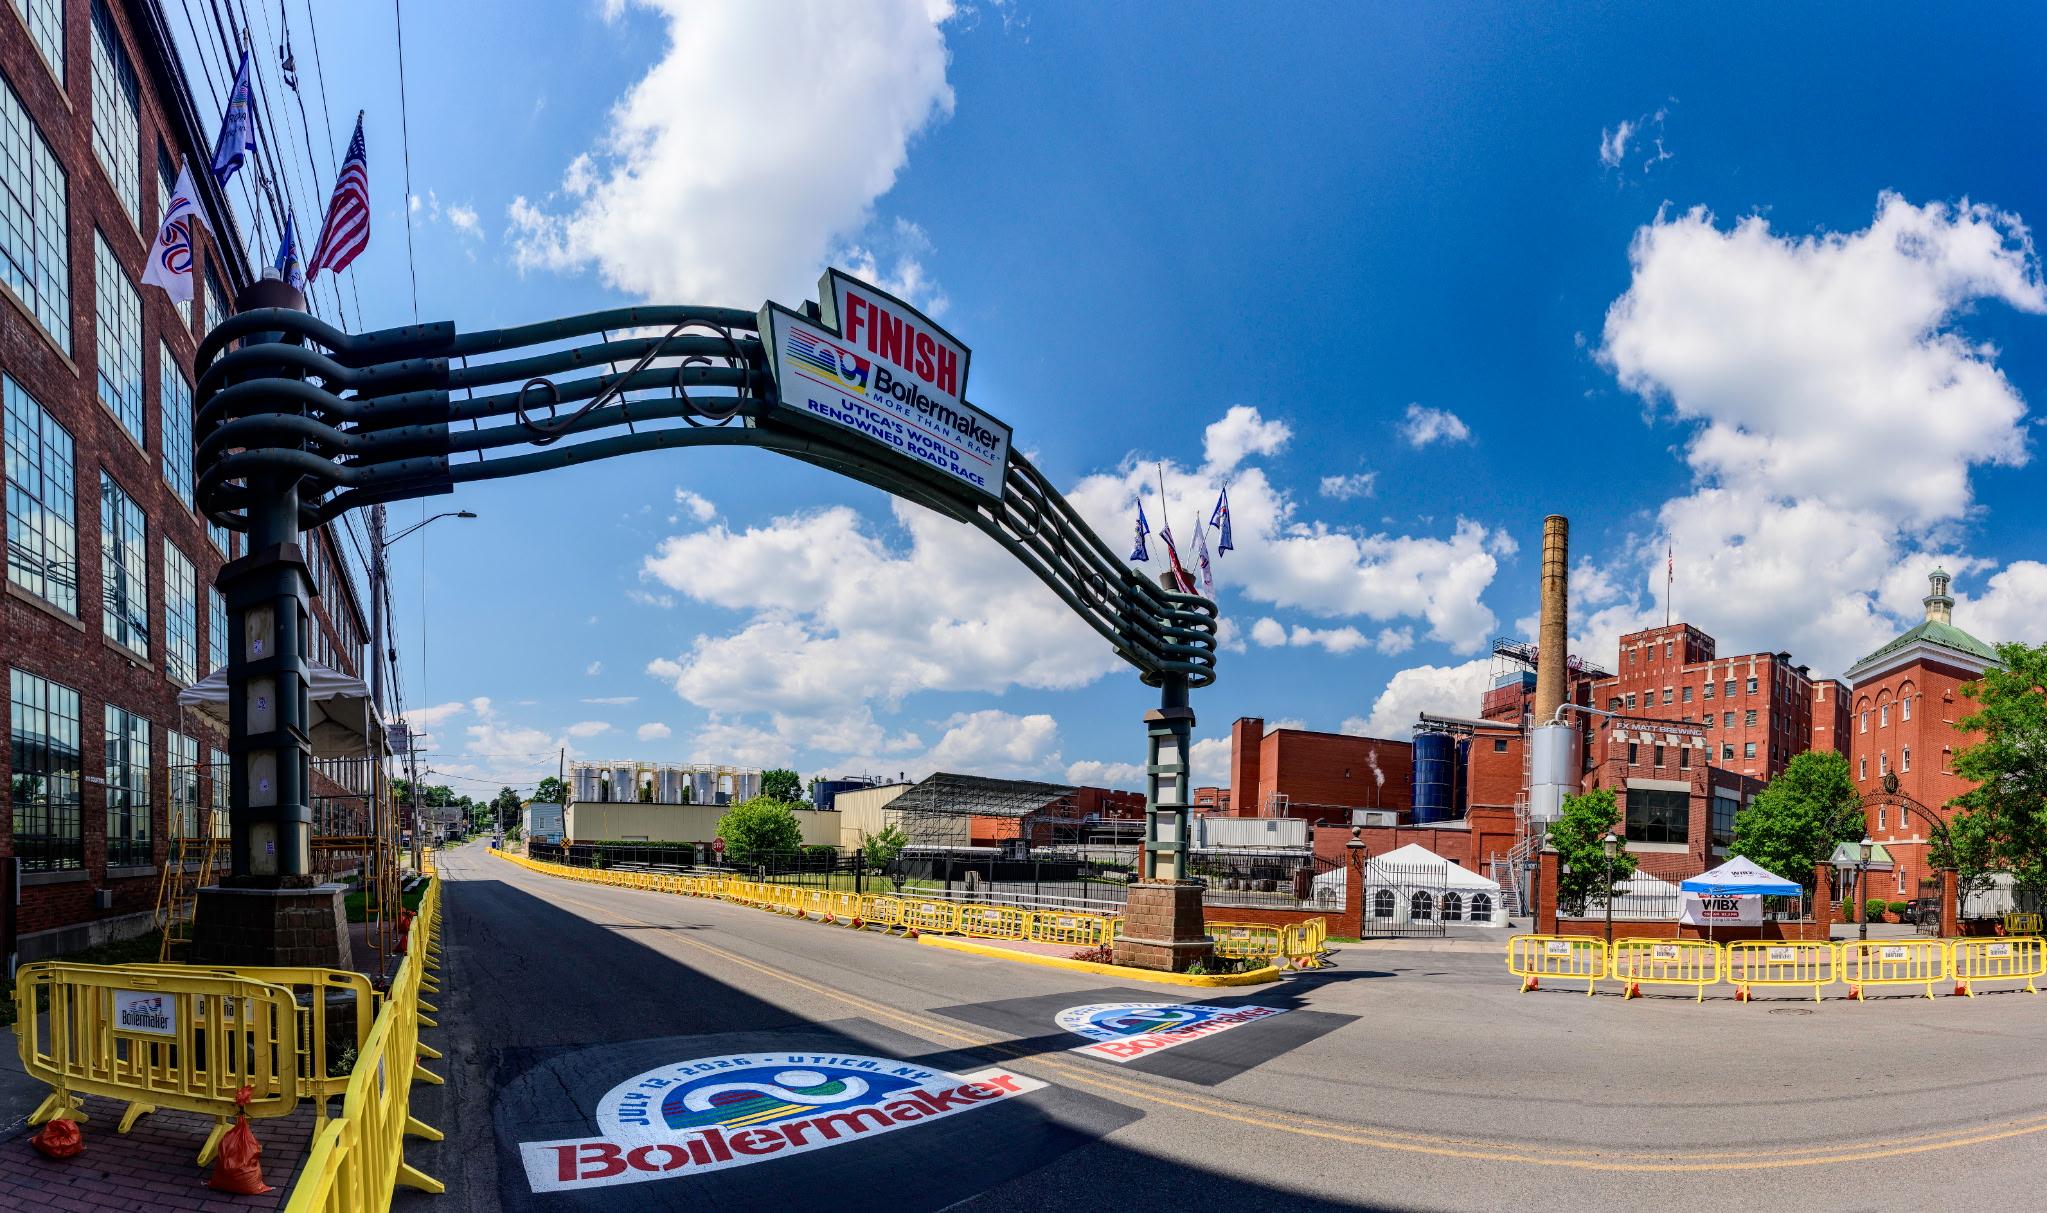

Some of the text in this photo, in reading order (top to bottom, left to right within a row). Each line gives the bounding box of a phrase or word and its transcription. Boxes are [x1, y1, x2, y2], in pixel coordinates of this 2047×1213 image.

[846, 291, 957, 397] FINISH
[841, 399, 960, 461] UTICA'S WORLD
[873, 362, 1001, 450] Boilermaker
[873, 394, 911, 417] MORE
[917, 414, 950, 436] THAN
[808, 398, 985, 487] RENOWNED ROAD RACE
[1631, 724, 1659, 733] MATT
[1659, 727, 1702, 736] BREWING
[1702, 899, 1739, 910] WIBX
[122, 1009, 169, 1030] Boilermaker
[1088, 1006, 1277, 1058] Boilermaker
[618, 1055, 934, 1126] JULY 12, 2026 UTICA, NY
[537, 1074, 1023, 1182] Boilermaker
